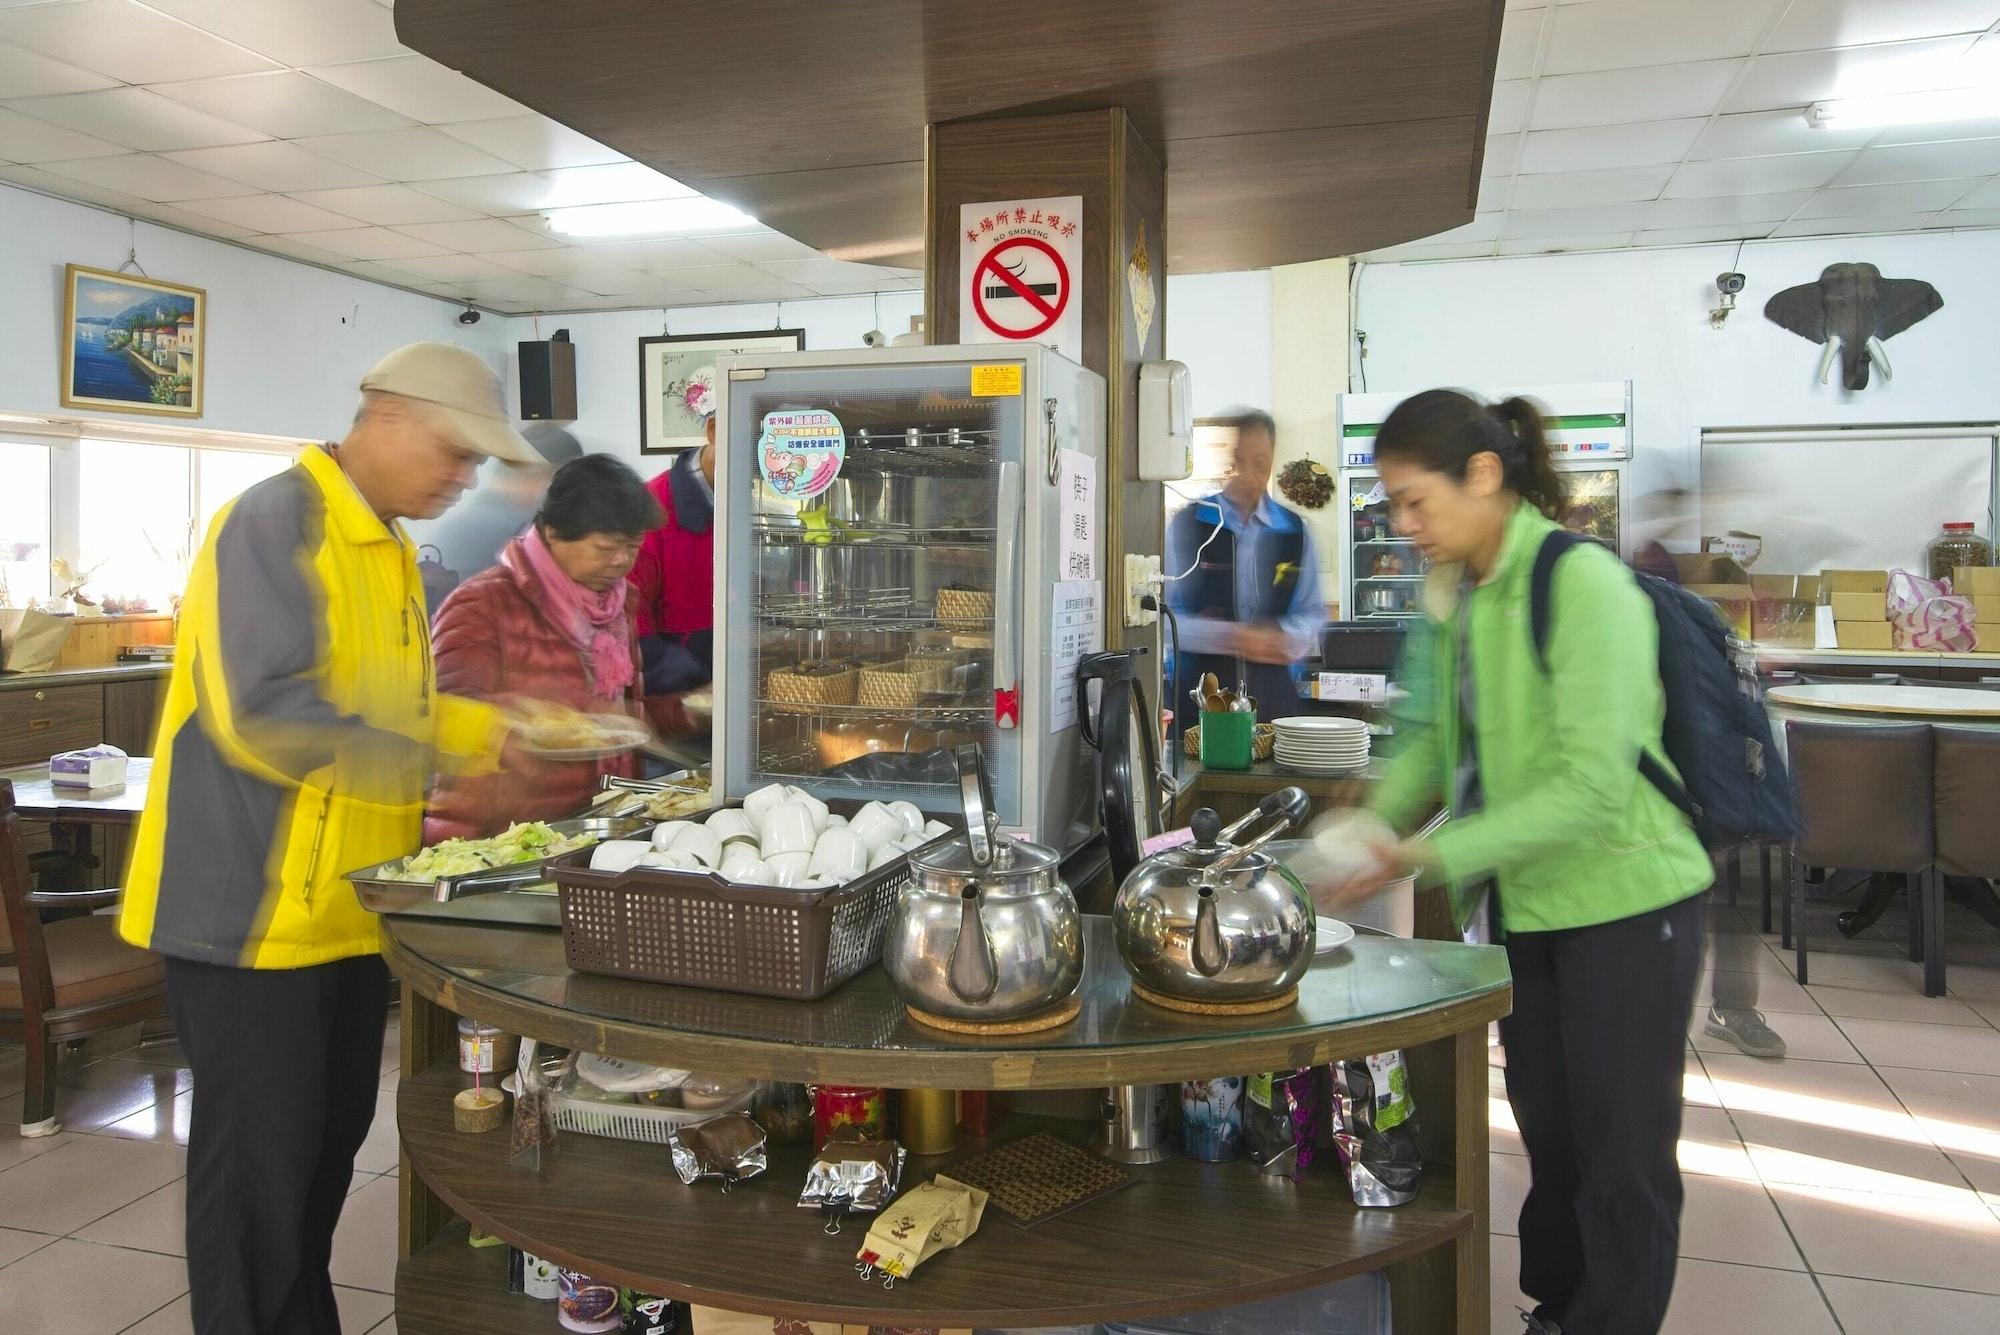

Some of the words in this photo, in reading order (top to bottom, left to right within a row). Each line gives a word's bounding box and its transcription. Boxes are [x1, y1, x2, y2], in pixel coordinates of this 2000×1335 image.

[966, 207, 1077, 243] 本場所禁止吸菸
[993, 233, 1006, 244] NO
[1008, 228, 1049, 240] SMOKING
